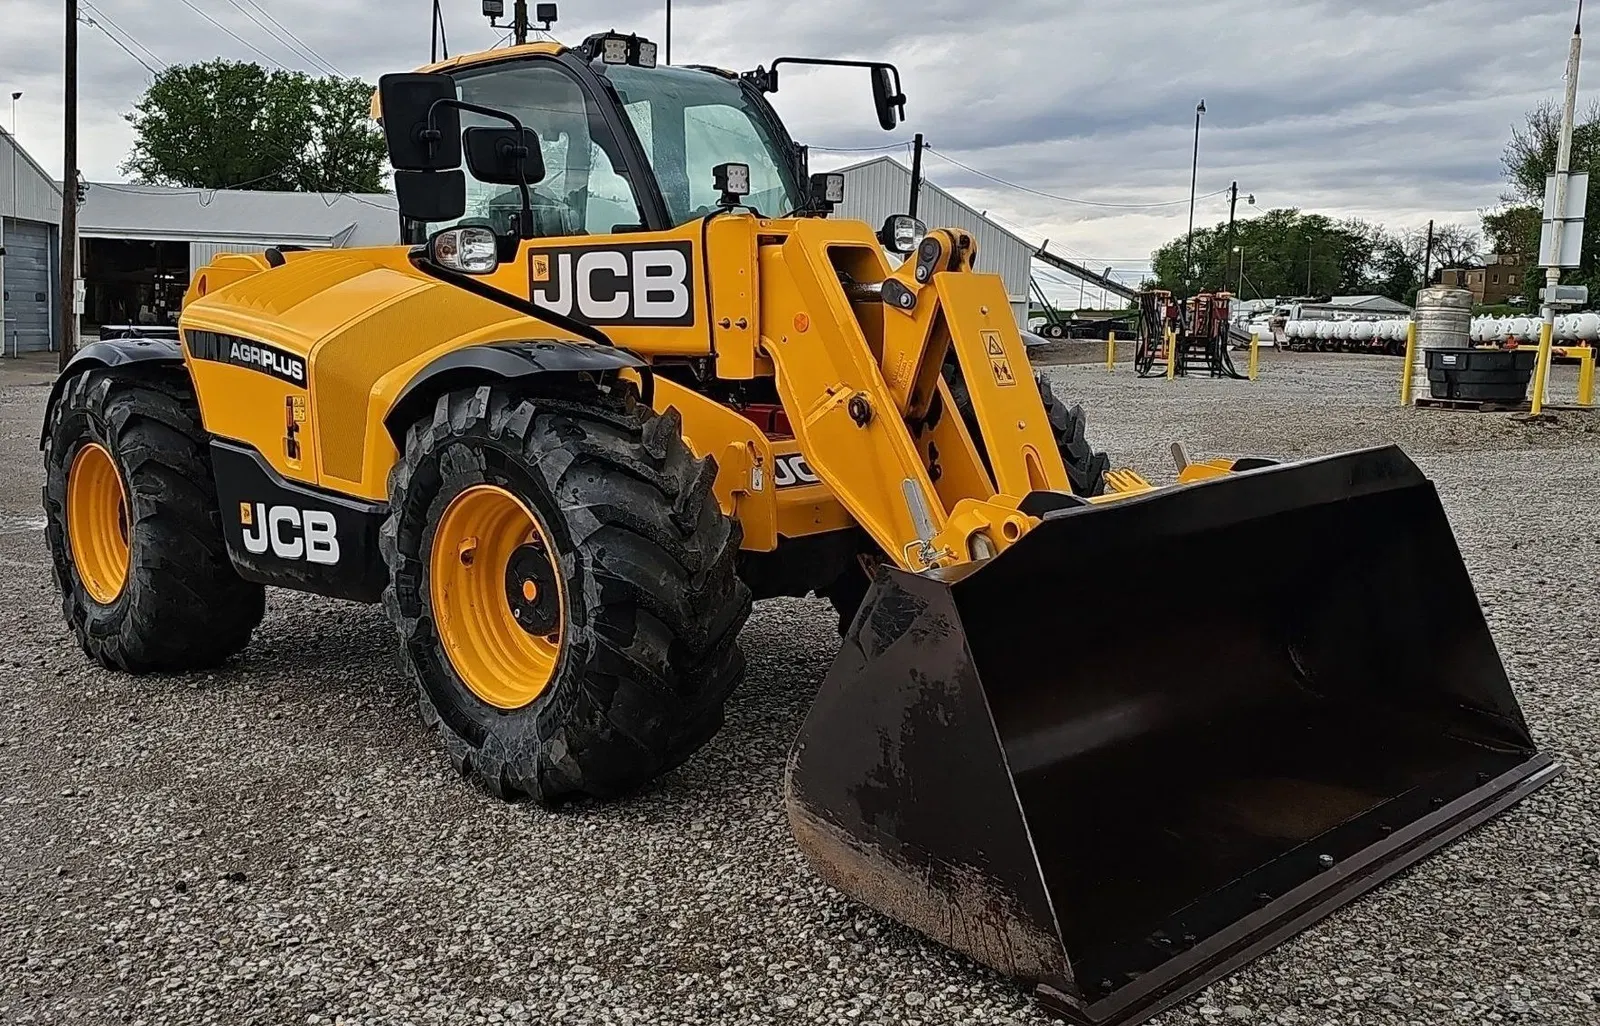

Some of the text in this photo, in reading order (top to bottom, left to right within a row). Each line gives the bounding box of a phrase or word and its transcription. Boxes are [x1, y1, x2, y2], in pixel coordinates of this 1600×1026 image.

[533, 250, 689, 318] JCB
[775, 456, 819, 485] JC
[242, 503, 340, 565] JCB
